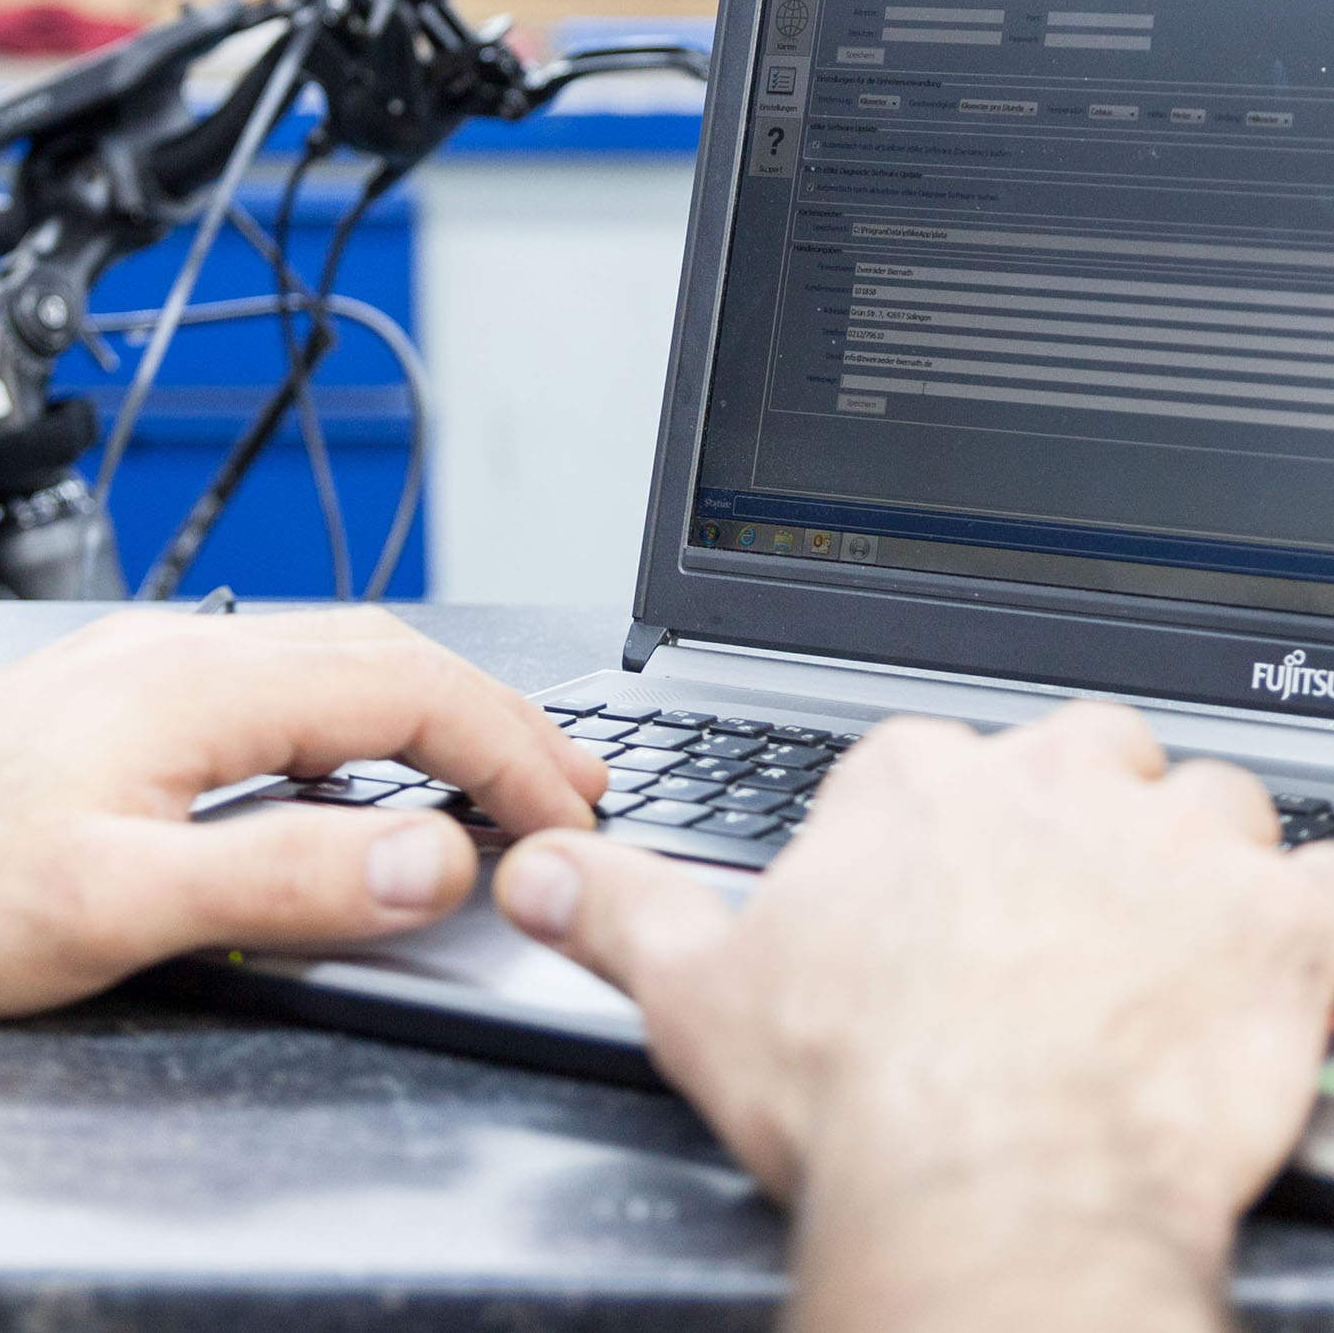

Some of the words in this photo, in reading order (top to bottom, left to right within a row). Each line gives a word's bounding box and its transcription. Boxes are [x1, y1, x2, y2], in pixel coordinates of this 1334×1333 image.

[777, 42, 797, 51] Karten
[859, 98, 888, 106] Kilometer
[759, 104, 798, 113] Einstellungen
[886, 267, 914, 277] Biernath
[906, 312, 932, 323] Solingen
